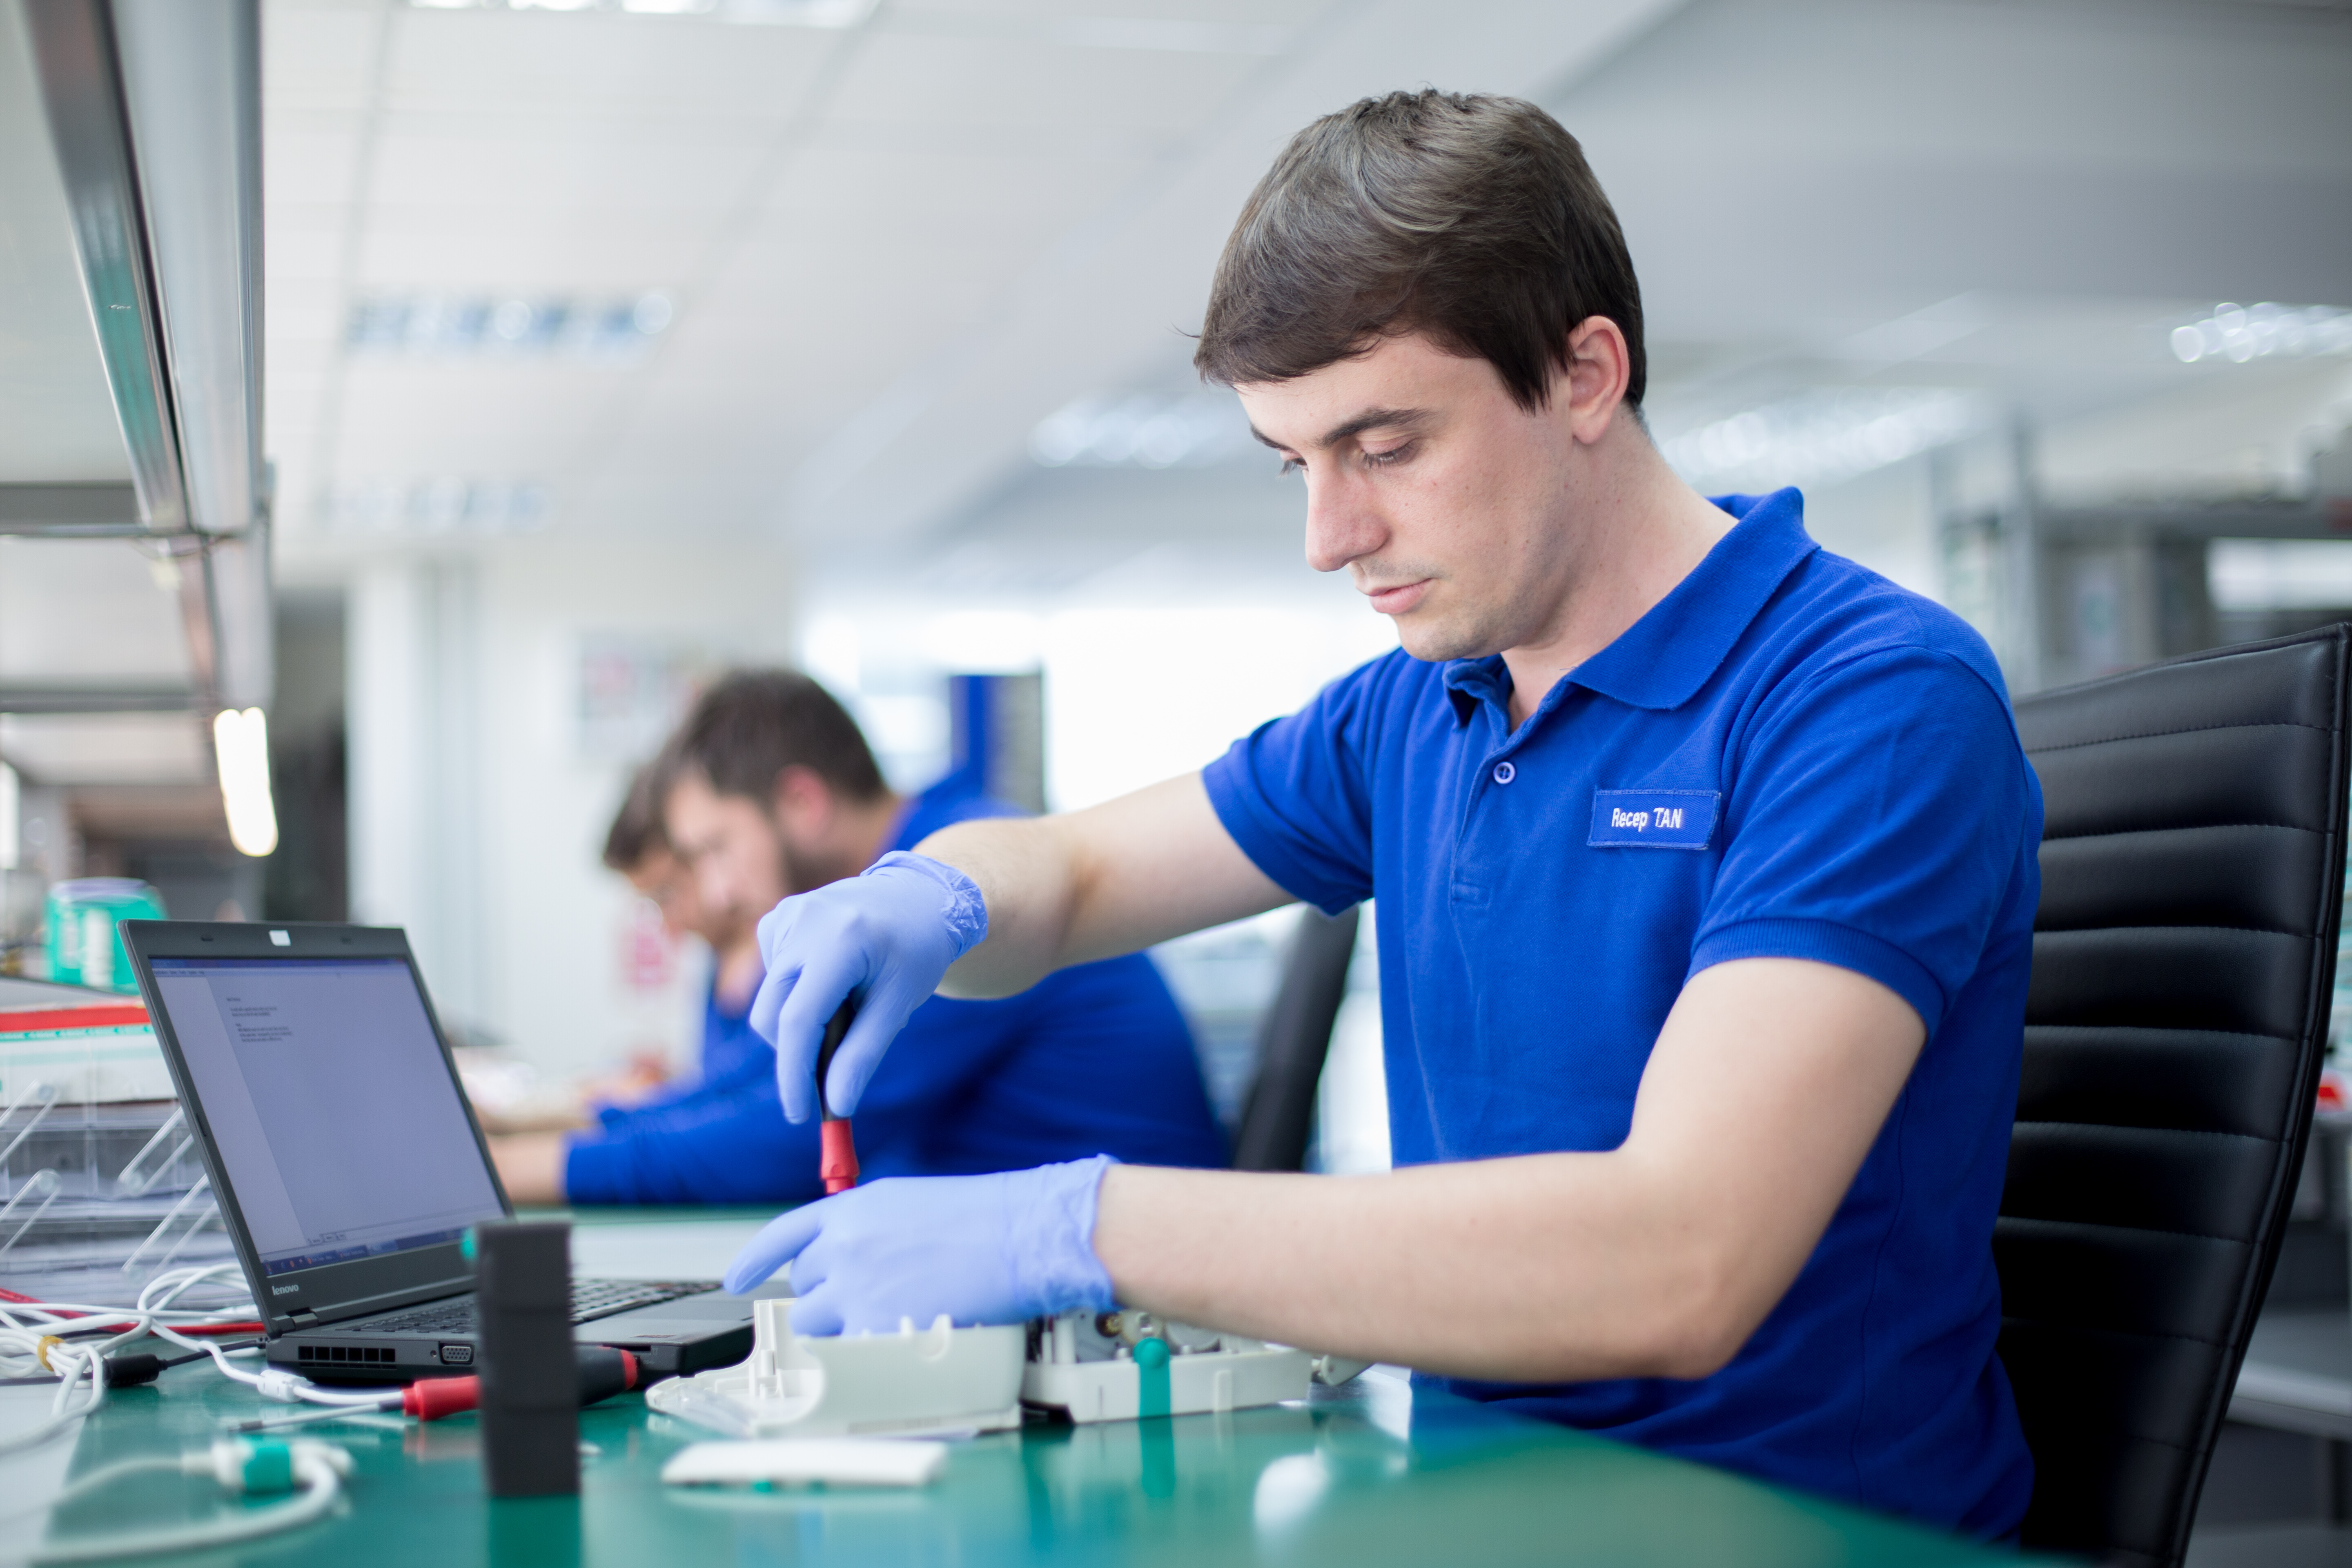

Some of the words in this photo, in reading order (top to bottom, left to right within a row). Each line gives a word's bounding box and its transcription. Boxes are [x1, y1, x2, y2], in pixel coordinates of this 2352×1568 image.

[1611, 808, 1648, 832] Recep
[1653, 807, 1682, 828] TAN
[272, 1284, 299, 1296] lenovo
